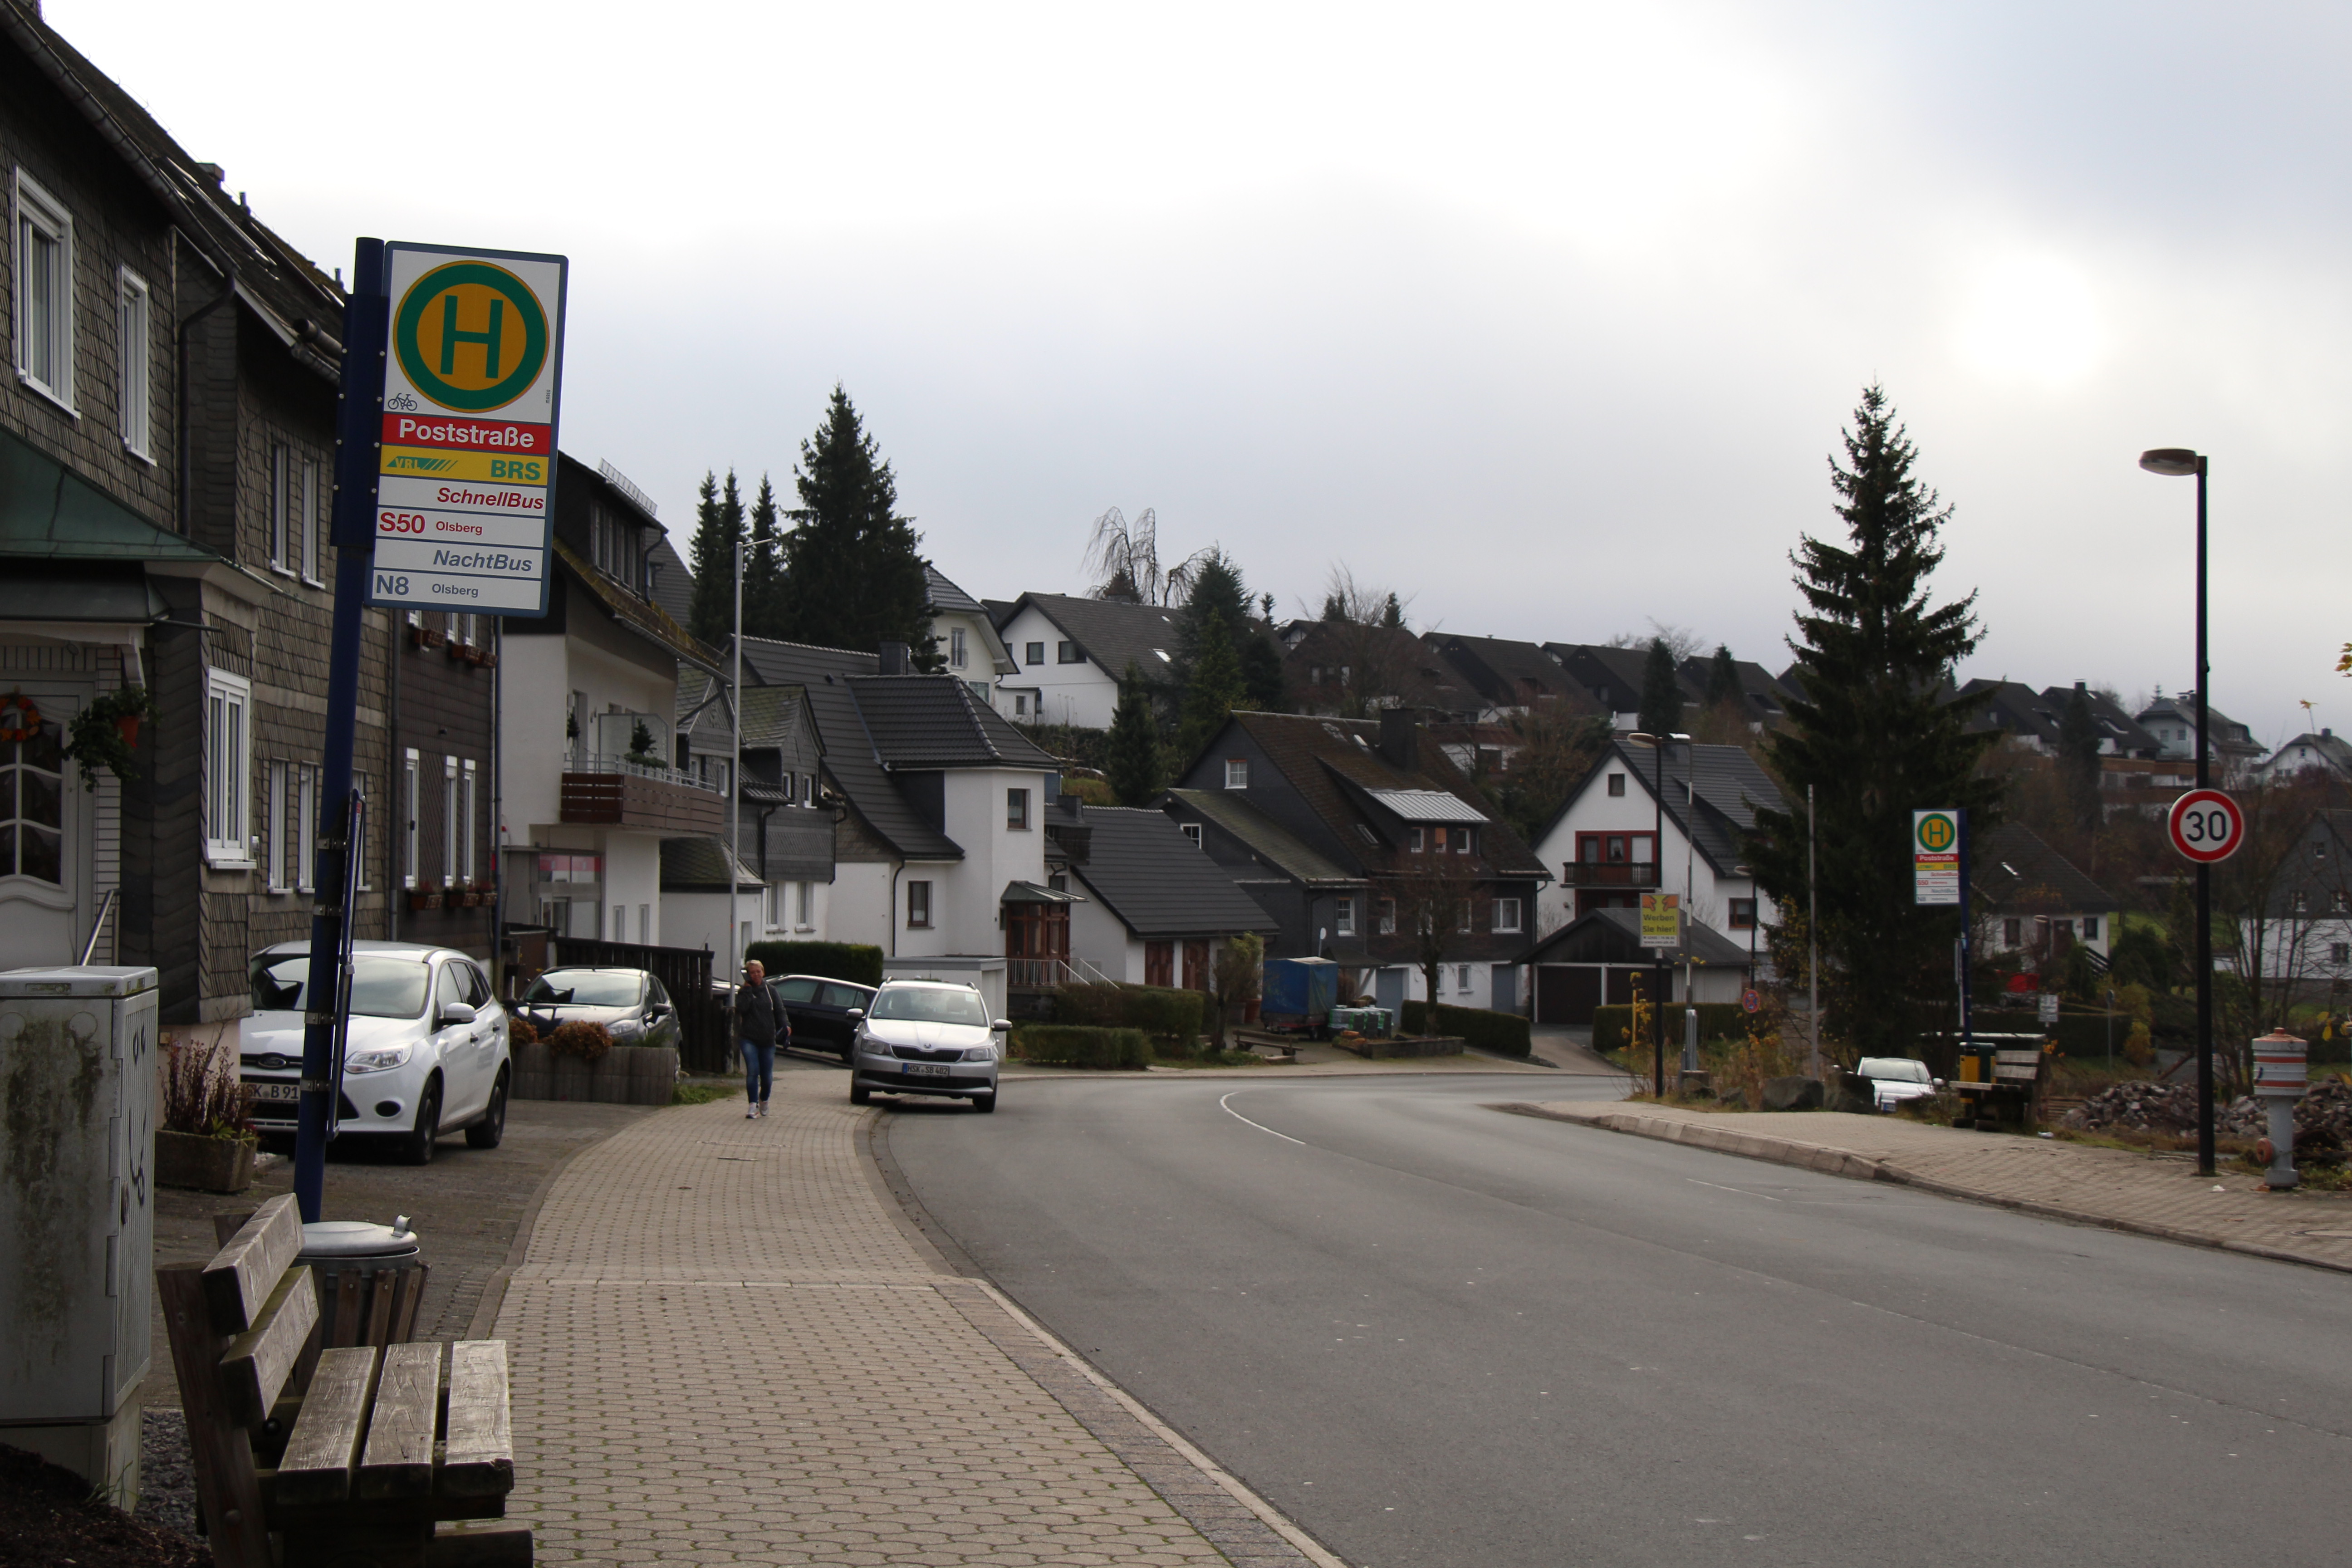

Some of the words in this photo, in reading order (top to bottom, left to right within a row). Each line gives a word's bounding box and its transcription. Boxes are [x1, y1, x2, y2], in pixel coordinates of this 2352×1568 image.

[440, 295, 504, 379] H
[399, 418, 535, 448] Poststraße
[396, 458, 421, 469] VRL
[490, 459, 541, 480] BRS
[437, 487, 544, 510] SchnellBus
[379, 511, 426, 534] S50
[436, 521, 483, 535] Olsberg
[433, 549, 533, 571] NachtBus
[376, 574, 410, 596] N8
[431, 583, 479, 598] Olsberg
[1929, 823, 1944, 843] H
[2185, 810, 2227, 842] 30
[907, 1065, 921, 1073] HSK
[271, 1085, 280, 1098] B
[282, 1086, 299, 1100] 91
